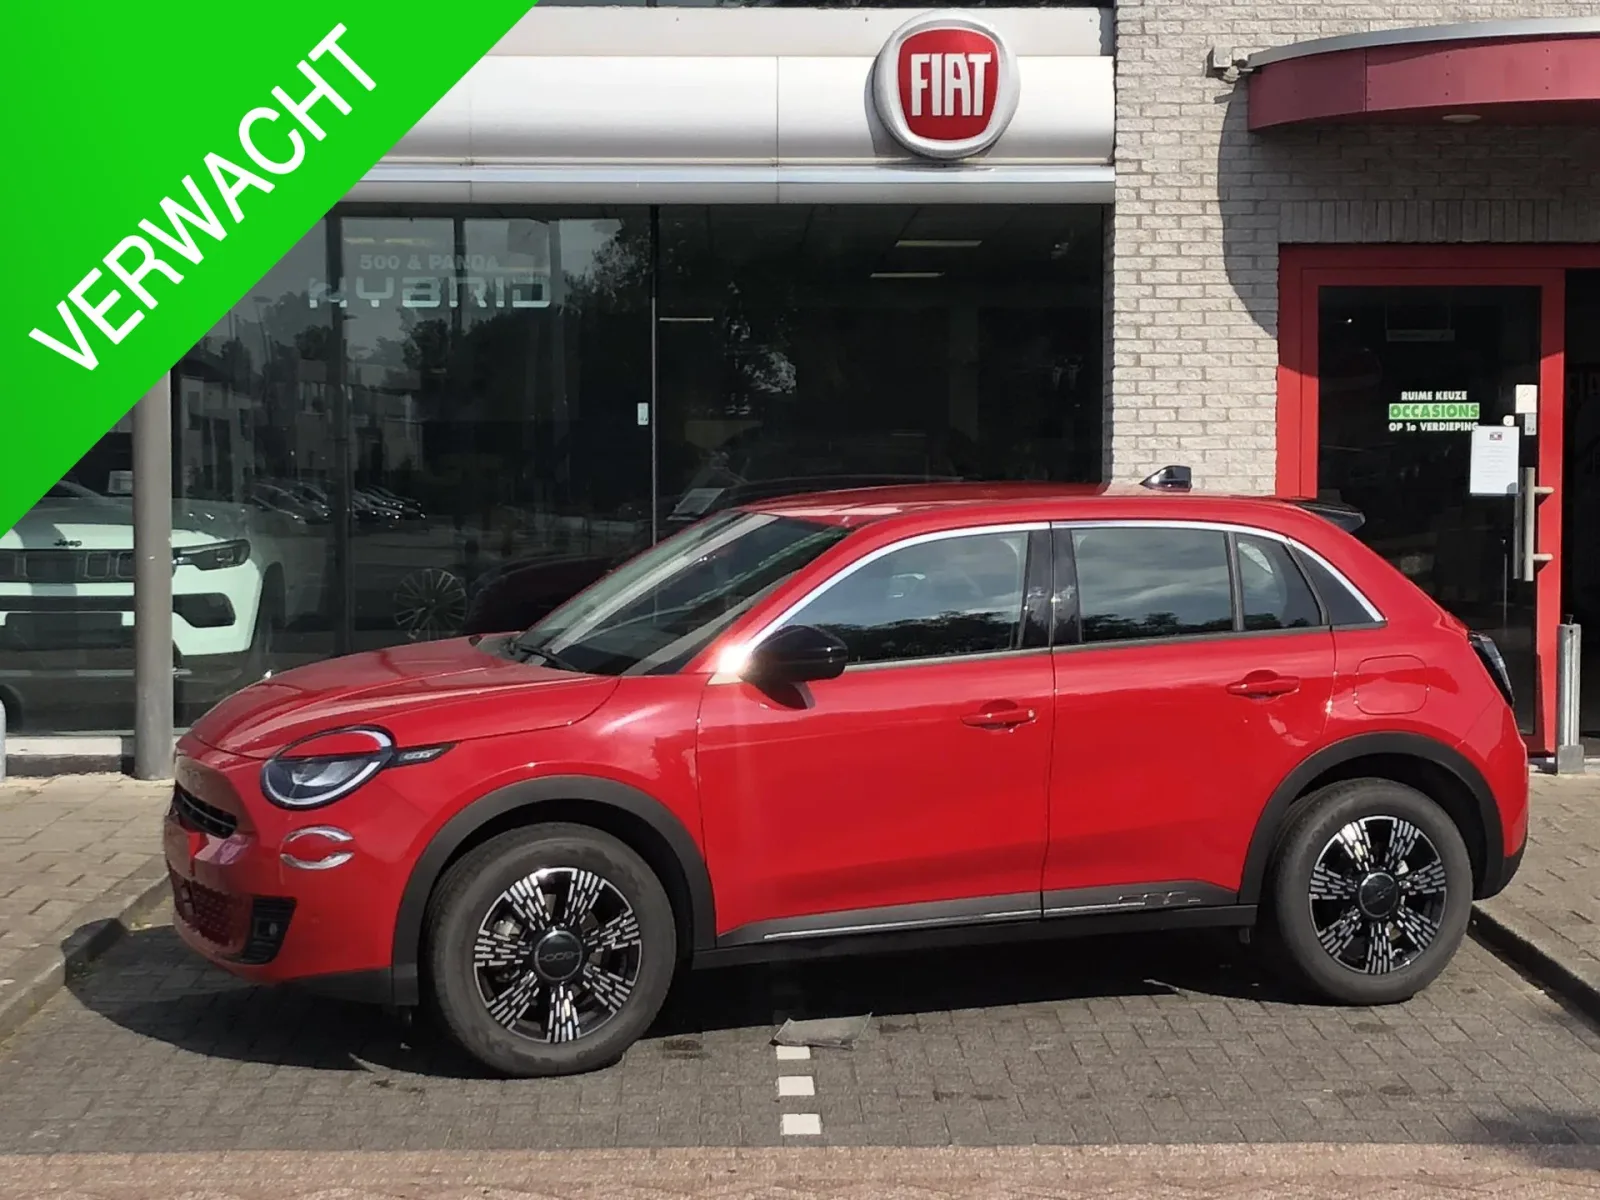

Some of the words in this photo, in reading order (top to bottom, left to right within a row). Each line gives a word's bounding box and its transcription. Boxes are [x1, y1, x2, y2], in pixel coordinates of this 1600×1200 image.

[911, 52, 991, 116] FIAT
[360, 255, 400, 270] 500
[407, 255, 423, 270] &
[429, 255, 500, 270] PANDA
[308, 277, 550, 308] HYBRID
[1401, 391, 1433, 401] RUIME
[1435, 390, 1467, 400] KEUZE
[1390, 404, 1479, 418] OCCASIONS
[1388, 422, 1404, 432] OP
